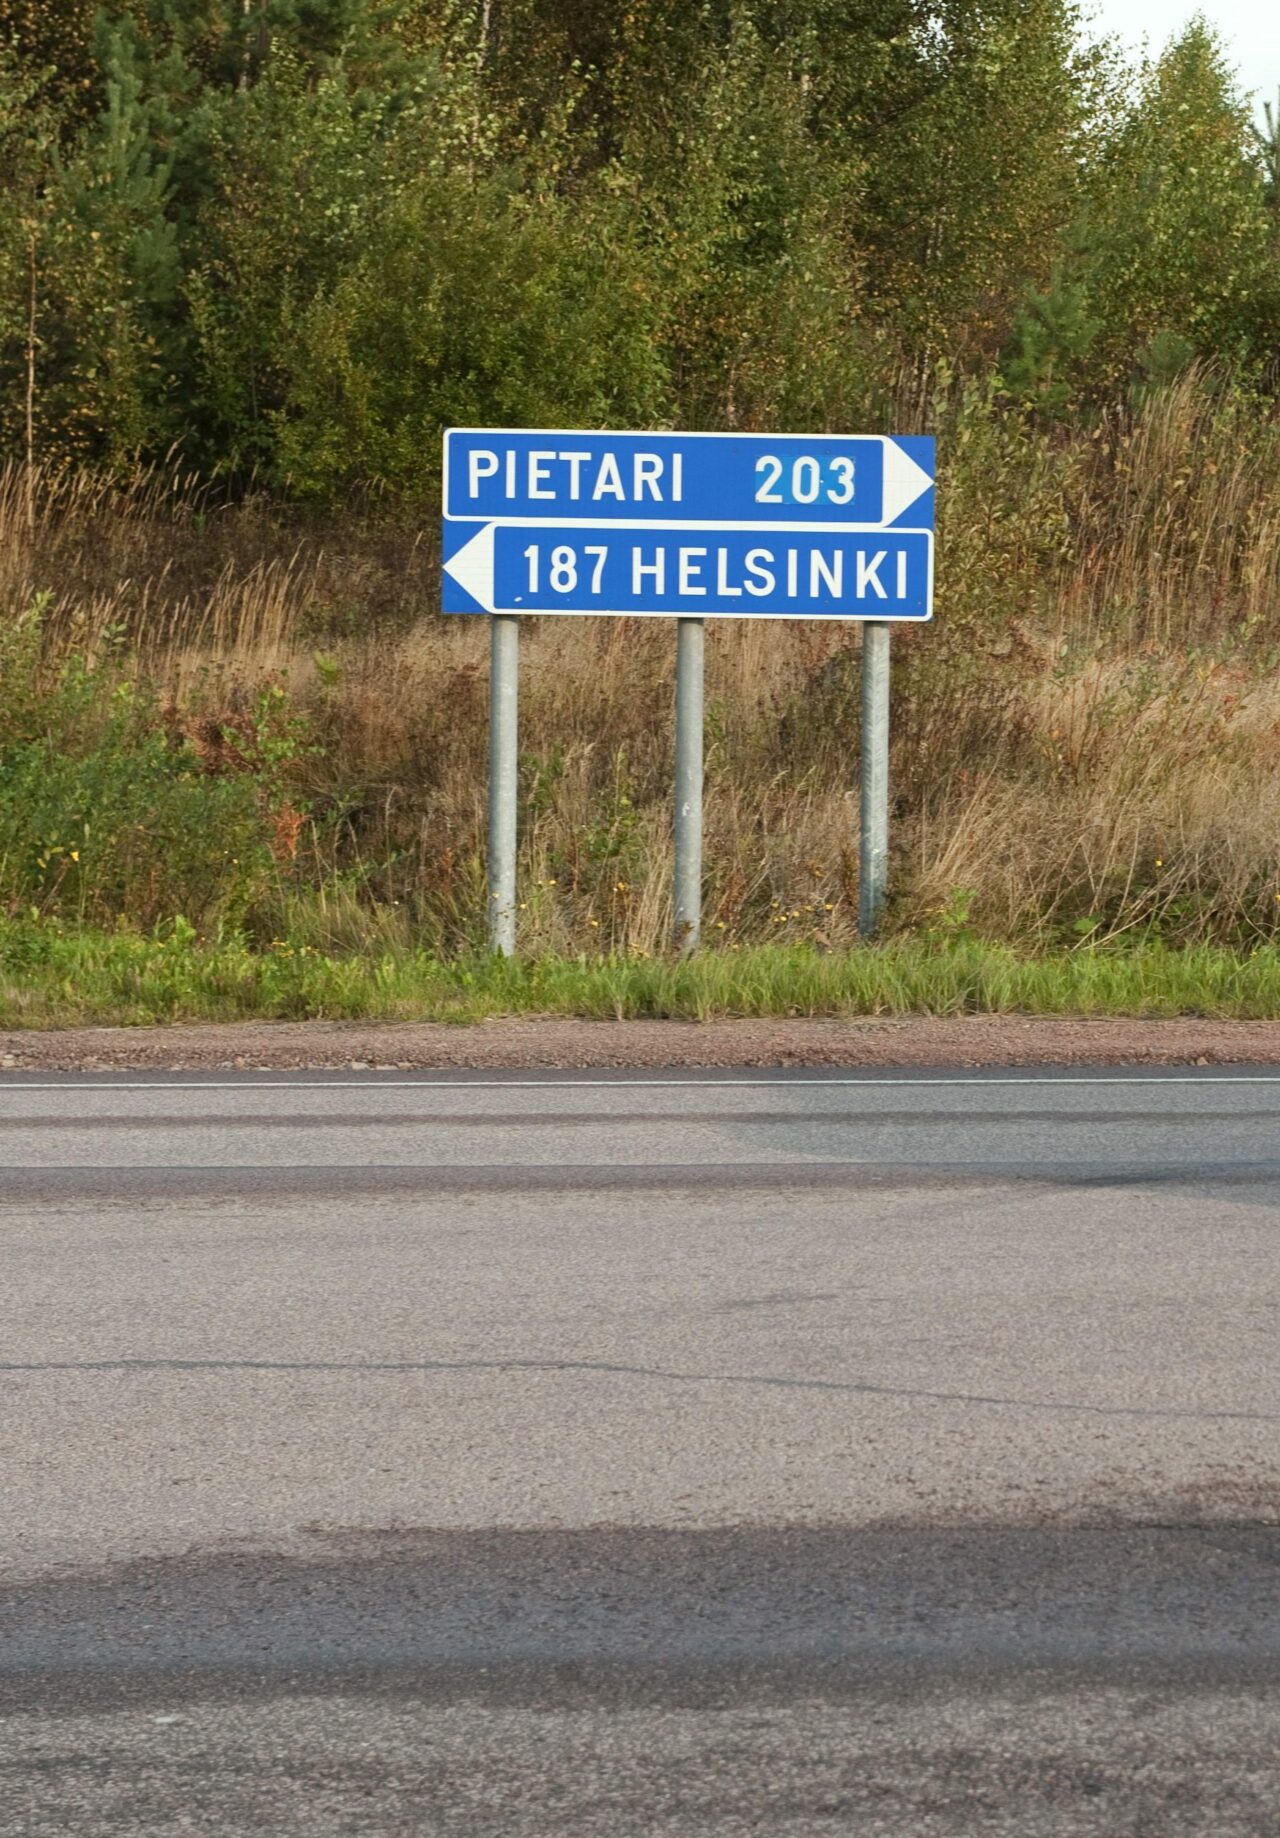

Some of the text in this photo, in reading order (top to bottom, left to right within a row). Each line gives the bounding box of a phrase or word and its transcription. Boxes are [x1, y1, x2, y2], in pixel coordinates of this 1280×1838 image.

[468, 450, 855, 504] PIETARI 203
[524, 544, 907, 599] 187 HELSINKI
